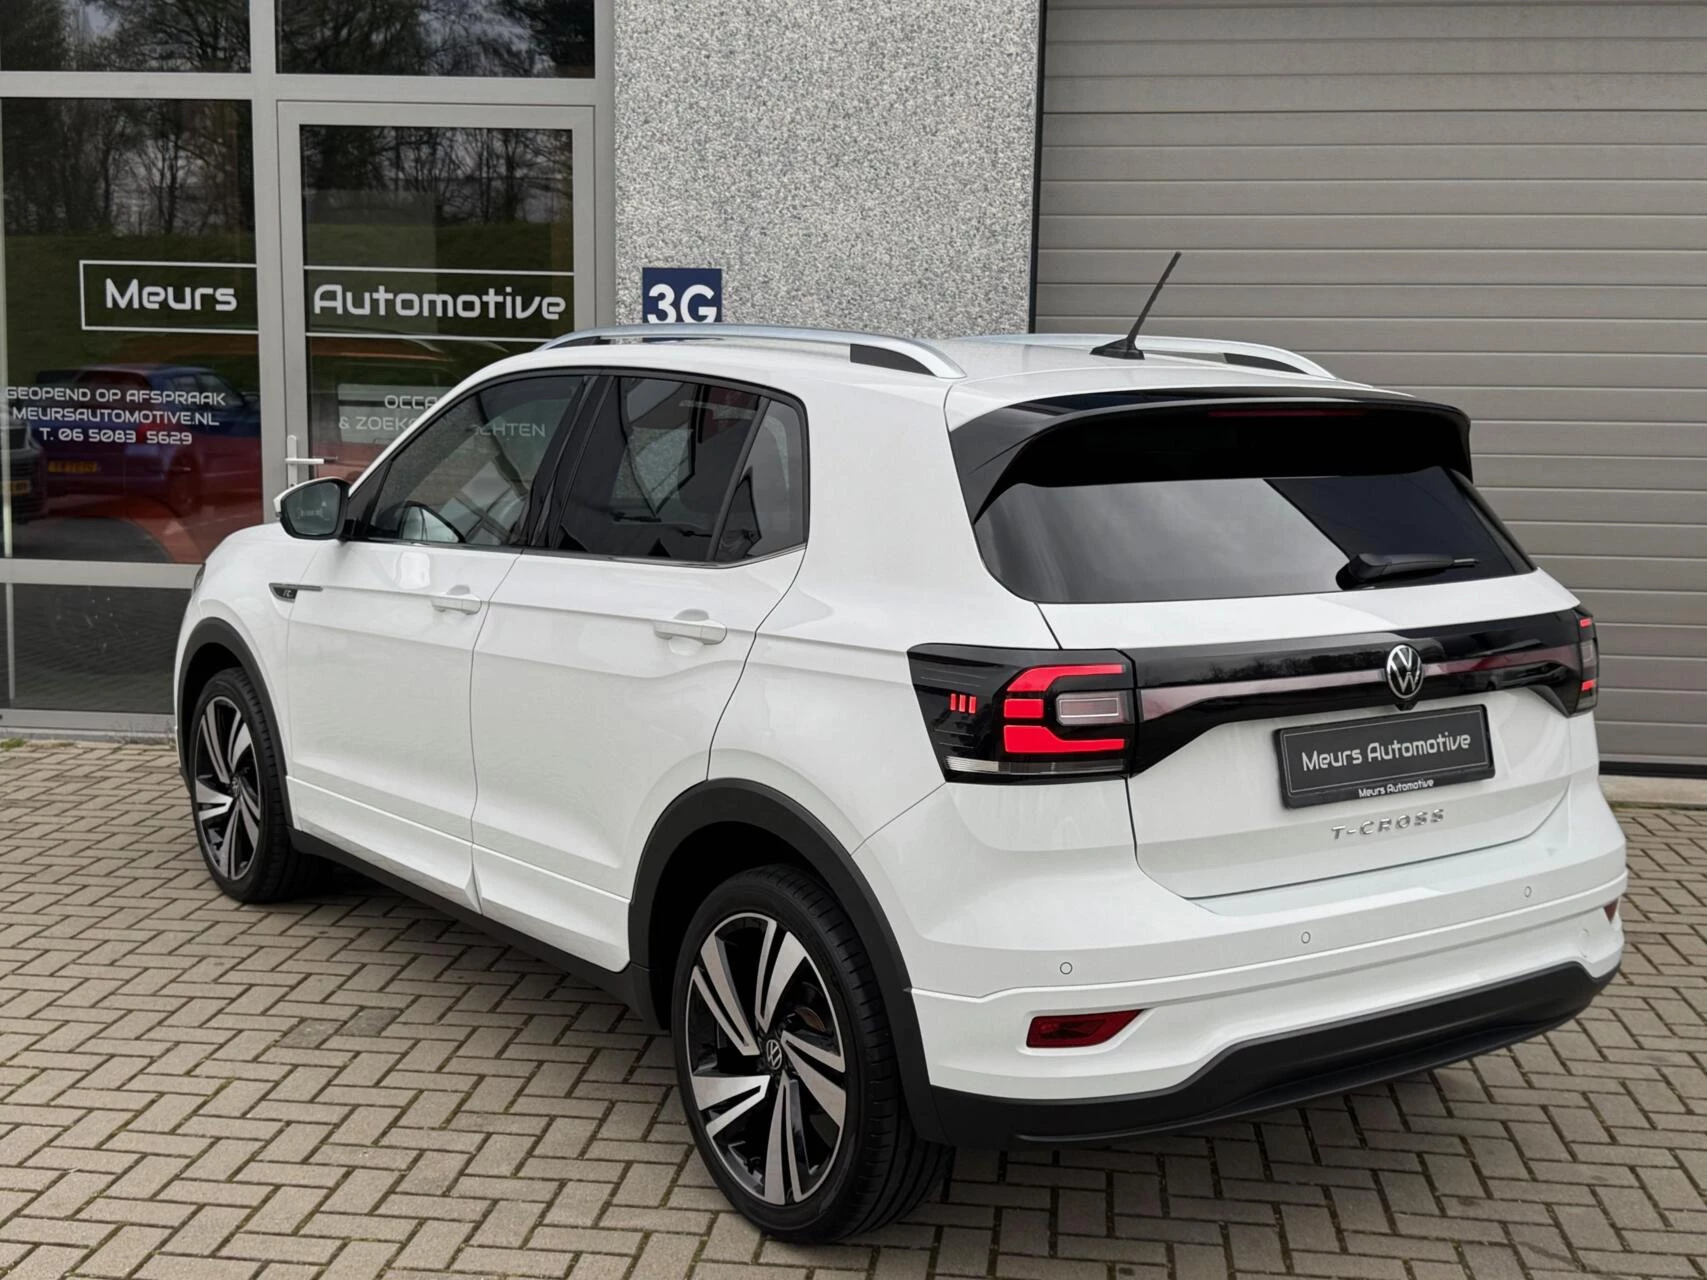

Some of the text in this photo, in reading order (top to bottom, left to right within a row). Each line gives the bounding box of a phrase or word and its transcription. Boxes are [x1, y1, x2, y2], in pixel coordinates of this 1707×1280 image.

[105, 278, 566, 320] Meurs Automotive
[647, 283, 718, 323] 3G
[5, 386, 226, 406] GEOPEND OP AFSPRAAK
[12, 407, 220, 426] MEURSAUTOMOTIVE.NL
[39, 427, 193, 445] T. 06 5083 5629
[1301, 731, 1471, 772] Meurs Automotive
[1358, 777, 1435, 798] Meurs Automotive
[1331, 808, 1445, 840] T-CROSS
